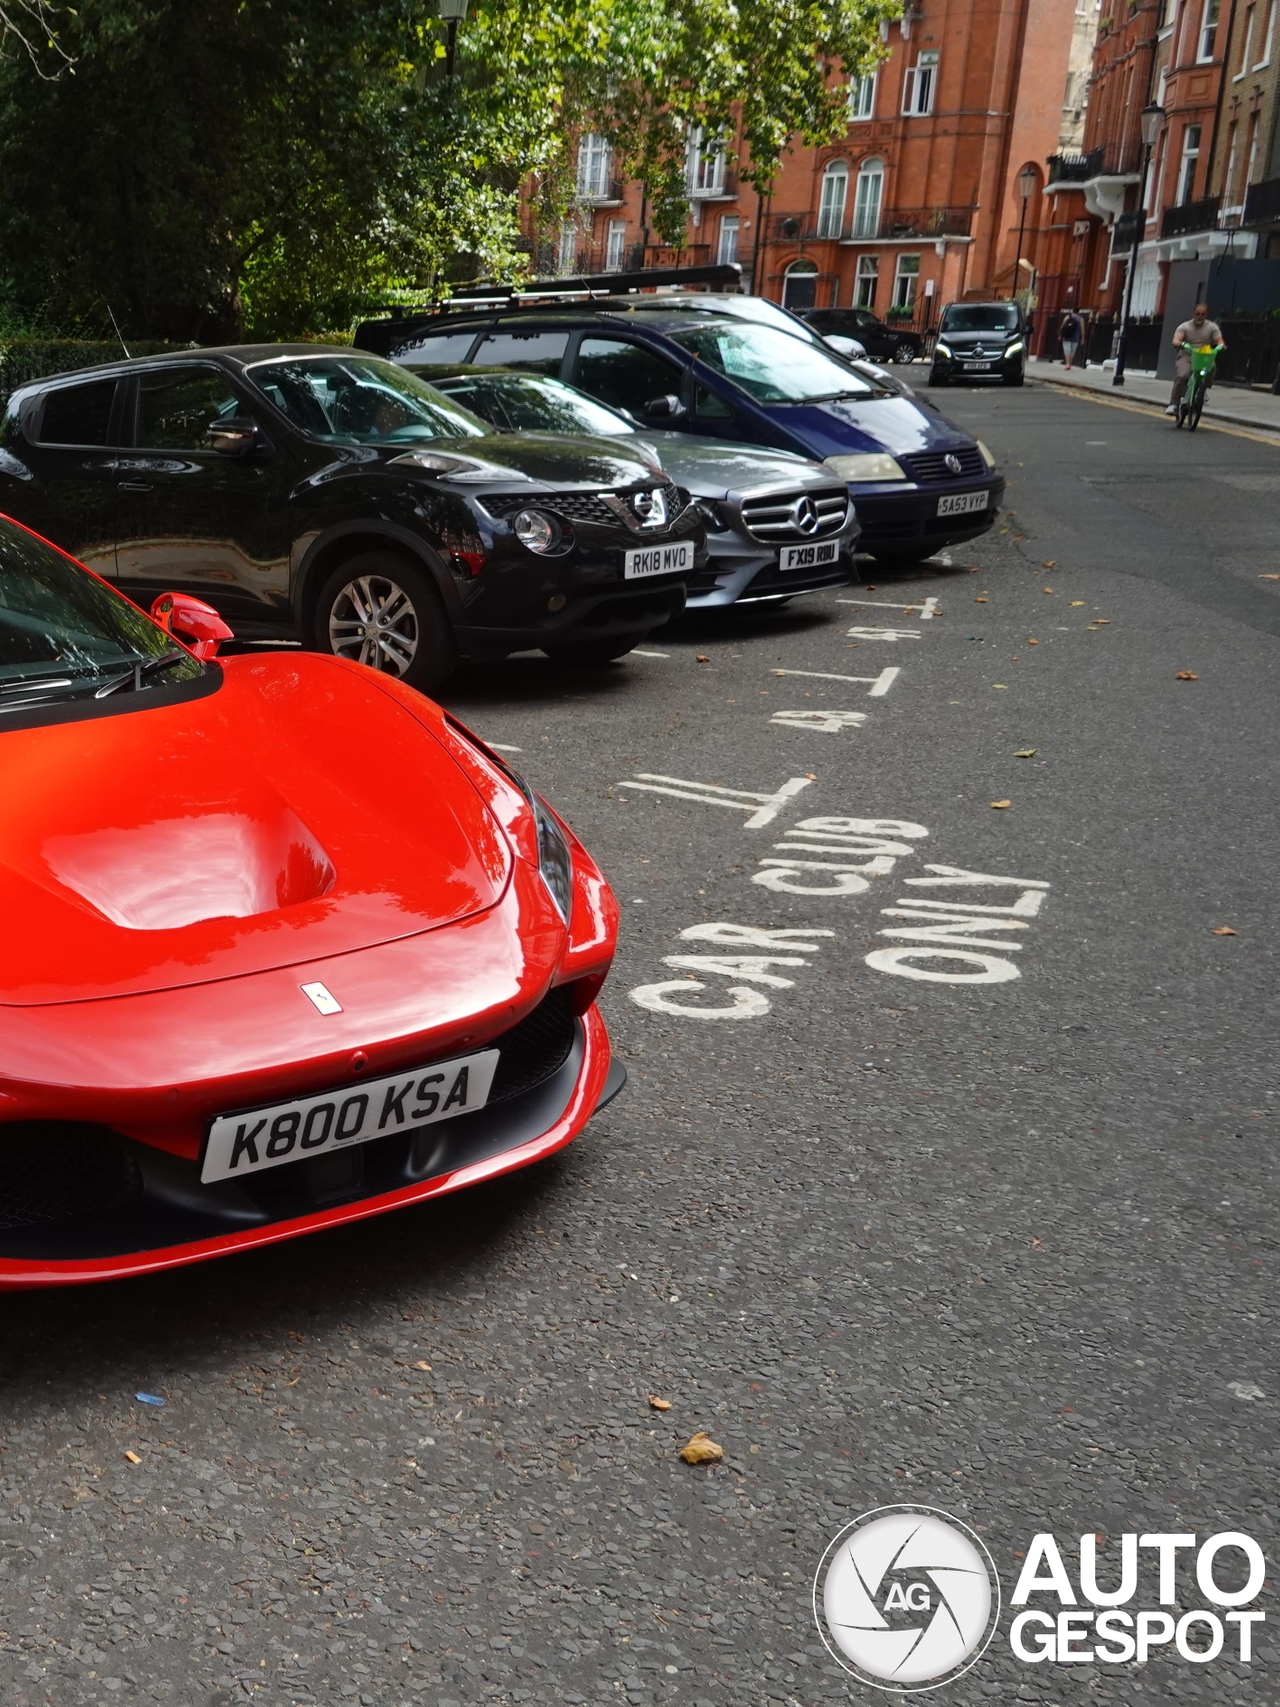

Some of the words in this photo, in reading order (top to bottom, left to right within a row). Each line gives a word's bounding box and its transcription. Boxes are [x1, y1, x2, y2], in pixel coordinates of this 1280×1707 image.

[942, 496, 967, 513] SA53
[970, 493, 986, 509] VYP
[633, 551, 660, 574] RK18
[664, 548, 686, 570] MVO
[788, 547, 815, 567] FX19
[627, 922, 836, 1020] CAR
[750, 816, 930, 896] CLUB
[864, 864, 1051, 984] ONLY
[228, 1093, 370, 1169] K800
[377, 1066, 469, 1130] KSA
